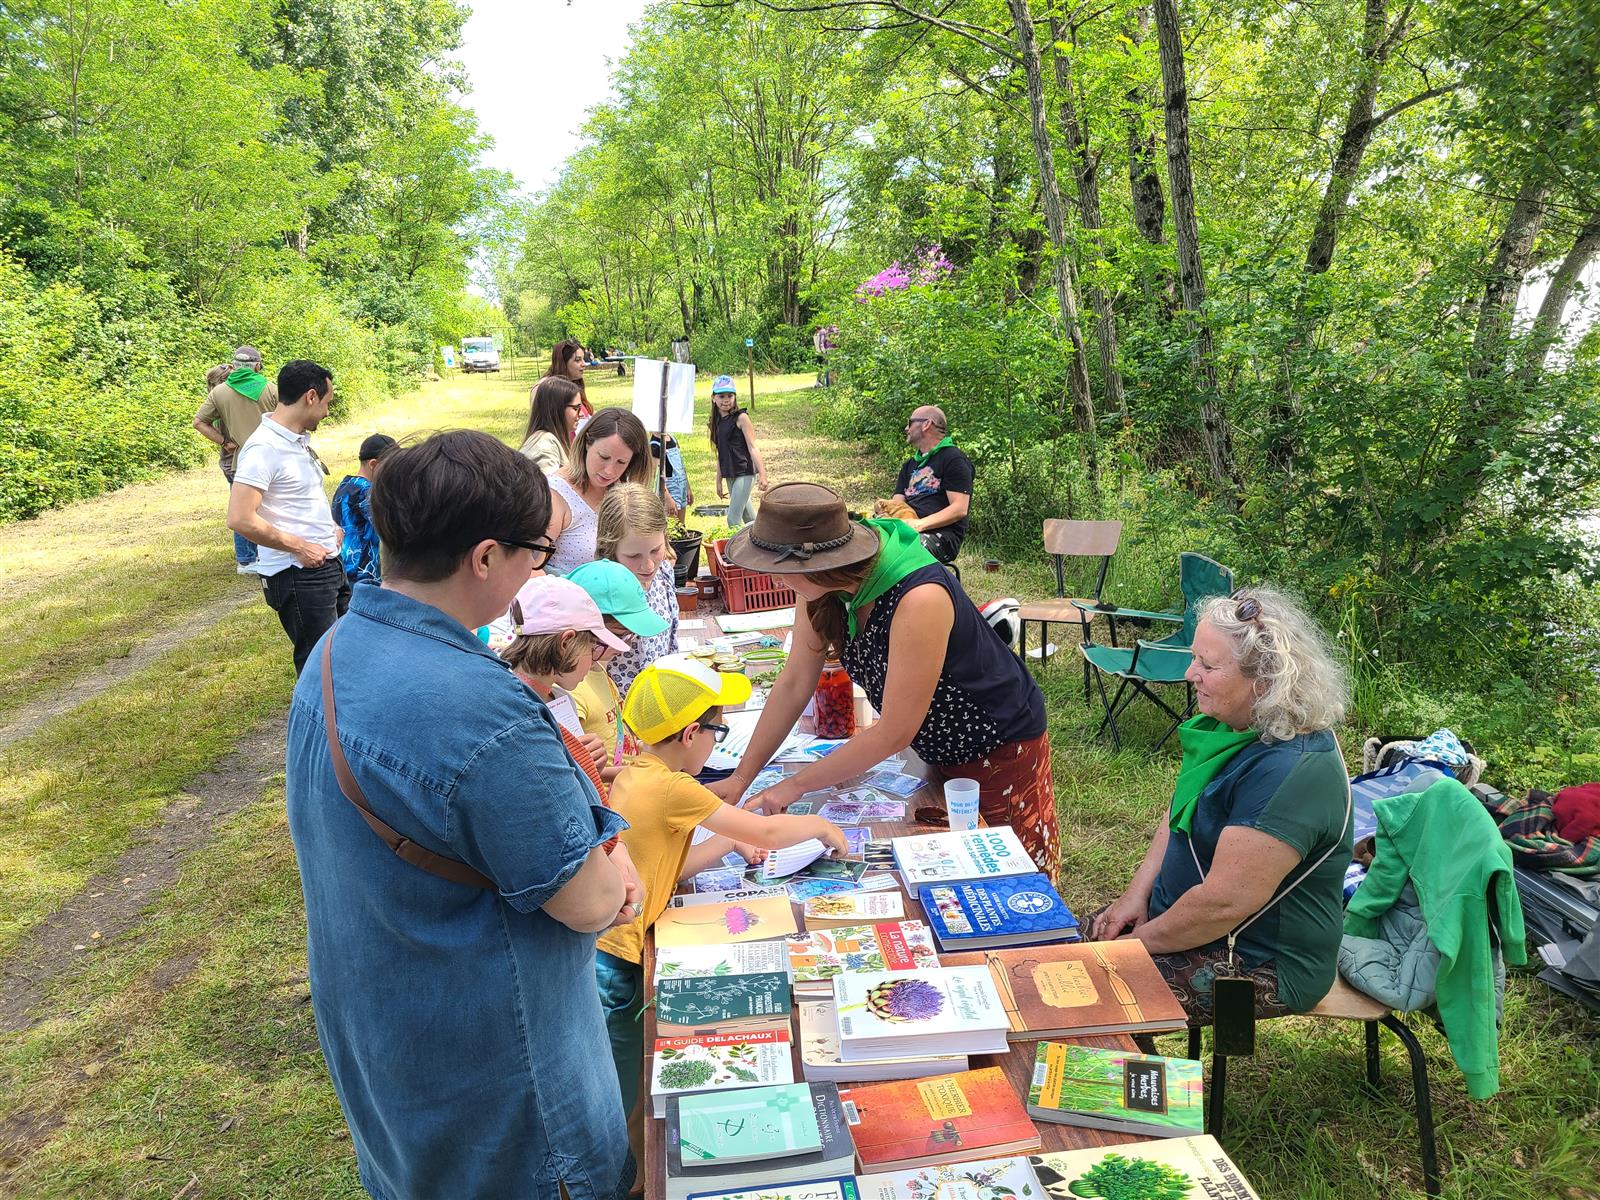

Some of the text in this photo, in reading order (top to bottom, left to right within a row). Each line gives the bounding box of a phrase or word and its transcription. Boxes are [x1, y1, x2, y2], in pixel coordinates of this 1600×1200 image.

[970, 834, 1001, 874] remèdes
[985, 832, 1011, 858] 1000
[961, 885, 993, 932] MÉDICINALES
[976, 888, 1004, 927] DES PLANTES
[889, 930, 910, 964] La nature
[673, 1032, 773, 1046] GUIDE DELACHAUX
[936, 1085, 956, 1114] TOXIQUE
[944, 1079, 967, 1114] L'HERBIER
[1139, 1074, 1151, 1099] Herbes,
[1150, 1070, 1160, 1106] Mauvaises
[815, 1094, 833, 1143] DICTIONNAIRE
[1212, 1158, 1253, 1200] DES HOMM
[1215, 1182, 1232, 1193] ET
